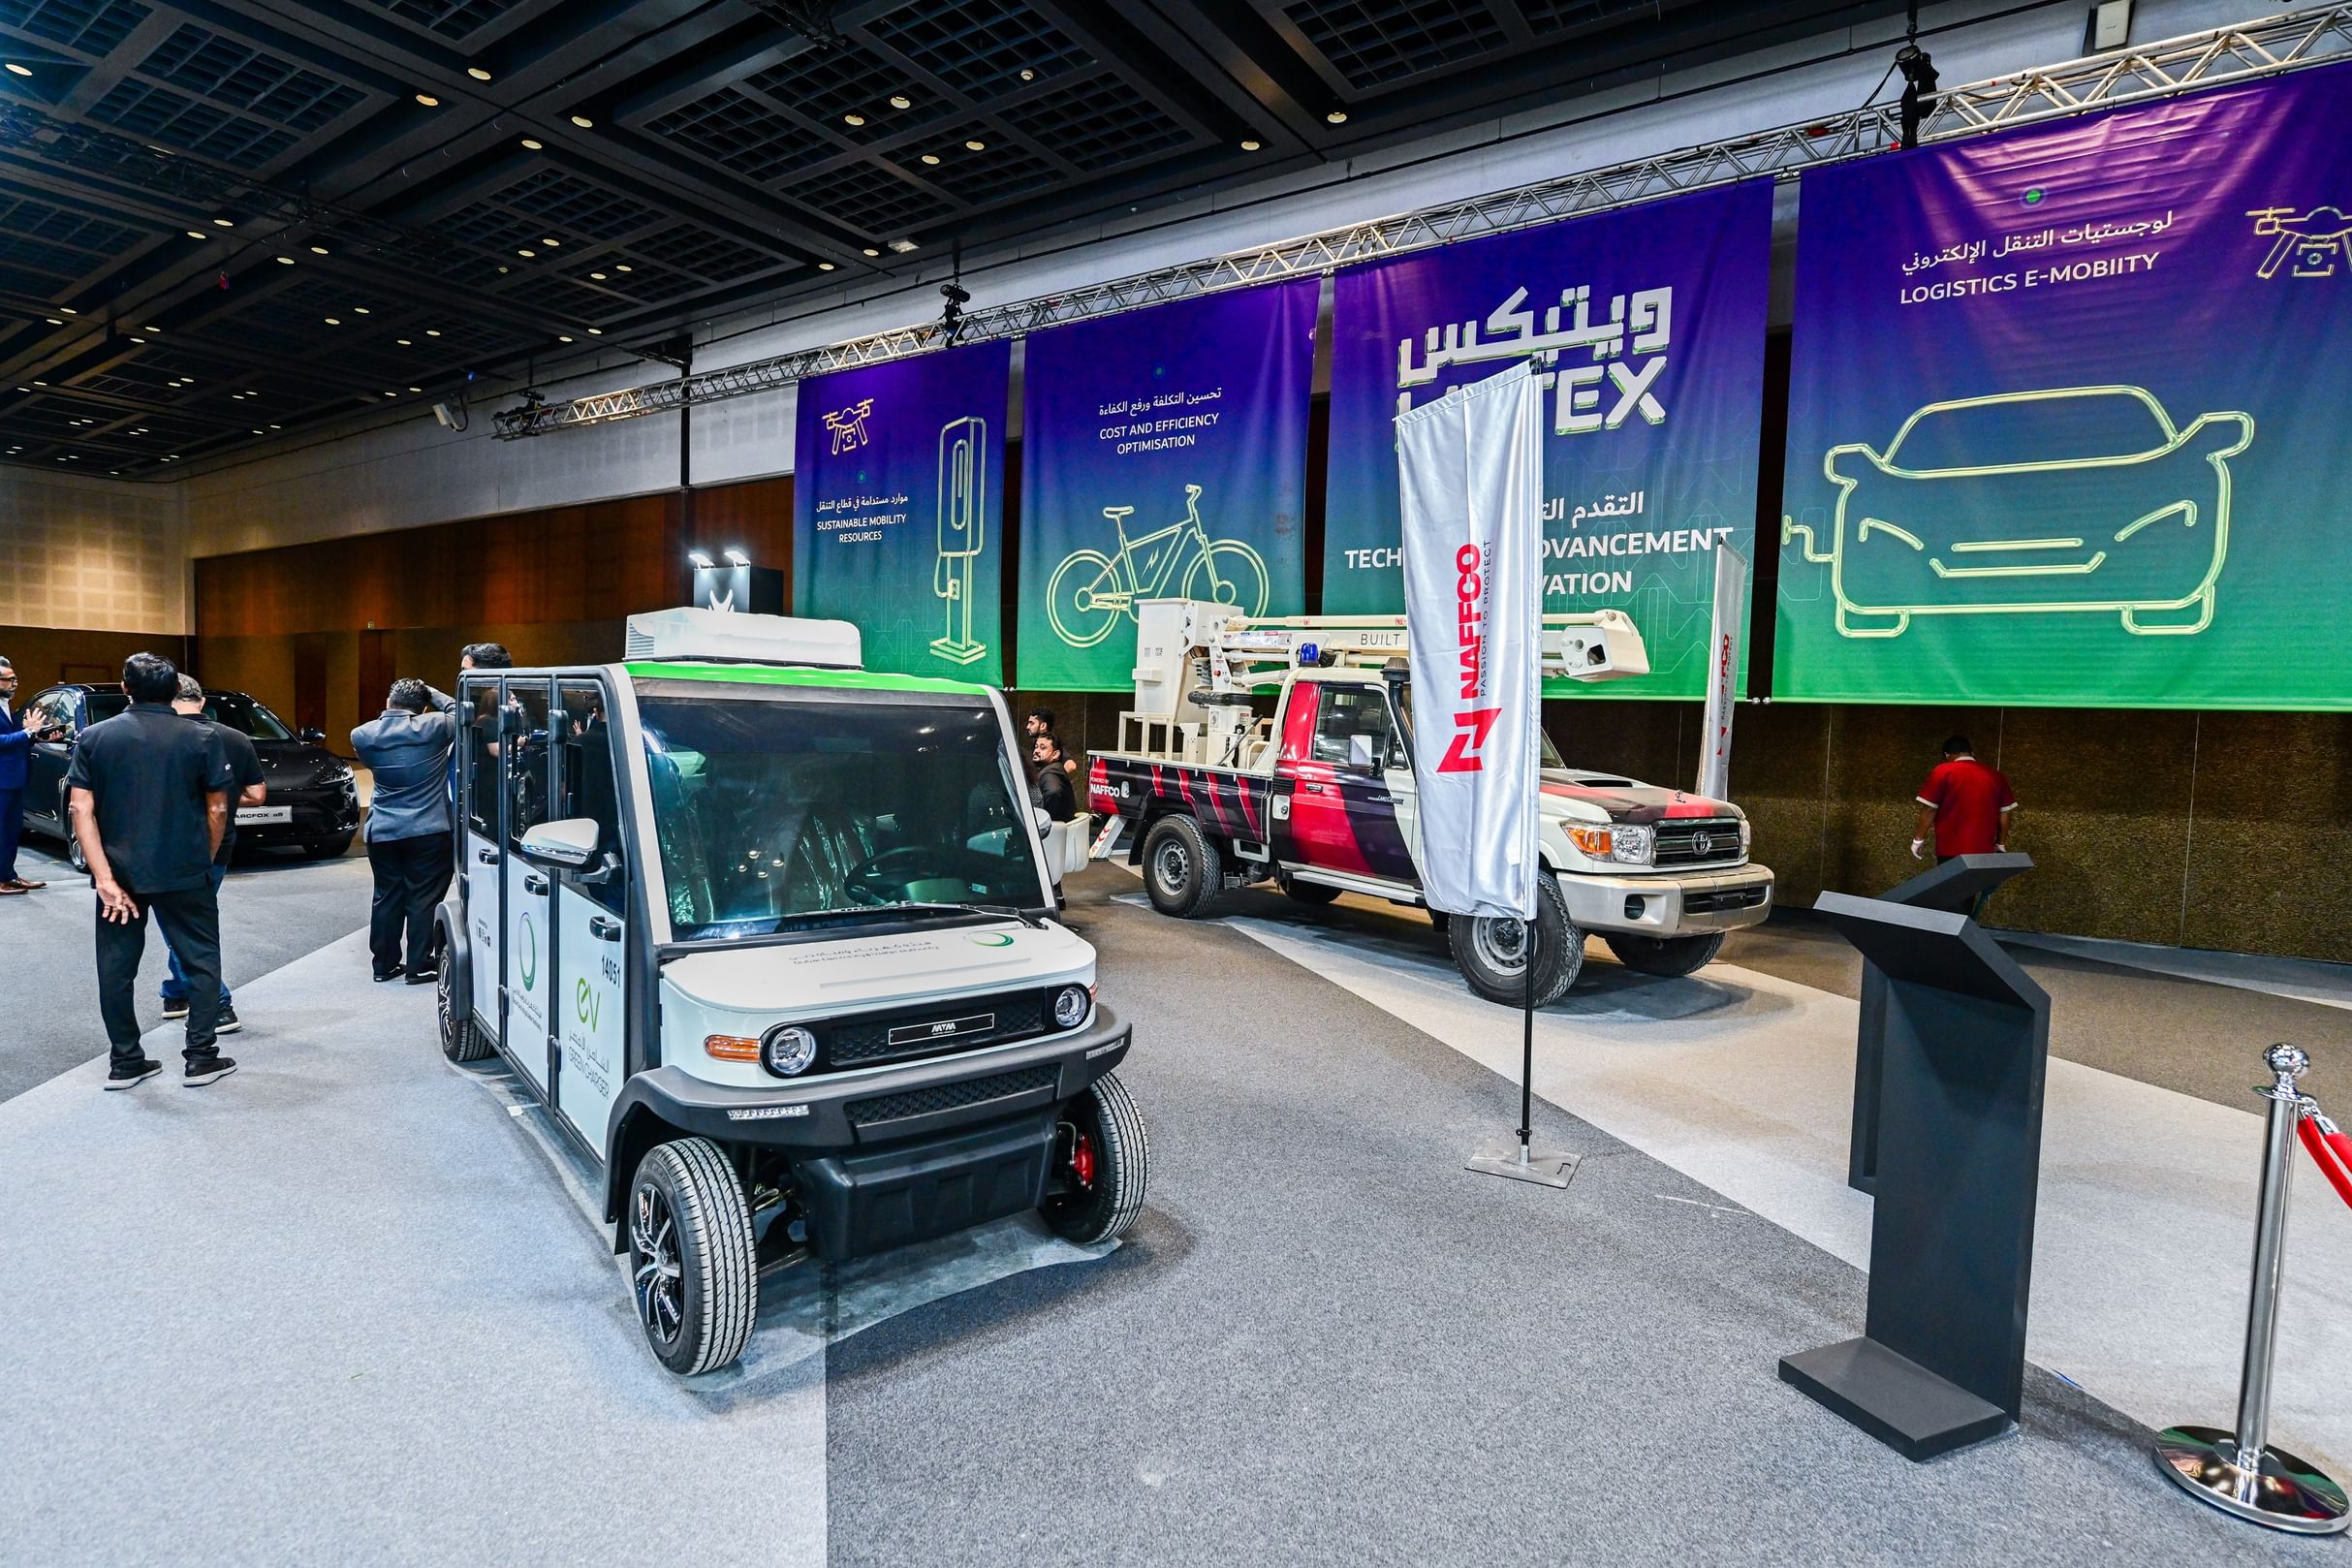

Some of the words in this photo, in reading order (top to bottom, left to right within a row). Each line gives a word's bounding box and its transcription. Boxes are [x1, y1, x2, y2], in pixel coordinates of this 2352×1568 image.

[2060, 210, 2173, 243] لوجستيات
[1992, 229, 2054, 258] التنقل
[1901, 240, 1987, 276] الإلكتروني
[1900, 273, 2018, 304] LOGISTICS
[2024, 252, 2160, 288] E-MOBIITY
[1152, 392, 1184, 407] التكلفة
[1186, 388, 1222, 405] تحسين
[1099, 400, 1128, 416] الكفاءة
[1130, 398, 1150, 417] ورفع
[1099, 425, 1127, 440] COST
[1129, 422, 1153, 437] AND
[1155, 413, 1220, 432] EFFICIENCY
[1116, 434, 1196, 455] OPTIMISATION
[816, 500, 835, 513] التنقل
[835, 497, 852, 514] قطاع
[853, 495, 861, 512] في
[861, 495, 890, 507] مستدامة
[890, 492, 909, 505] موارد
[1572, 491, 1645, 529] التقدم
[816, 517, 868, 531] SUSTAINABLE
[869, 514, 907, 526] MOBILITY
[838, 530, 883, 543] RESOURCES
[1483, 540, 1491, 605] PROTECT
[1456, 543, 1482, 700] NAFFCO
[1483, 611, 1489, 628] TO
[1361, 633, 1401, 645] BUILT
[1090, 783, 1120, 798] NAFFCO
[601, 955, 621, 988] 14051
